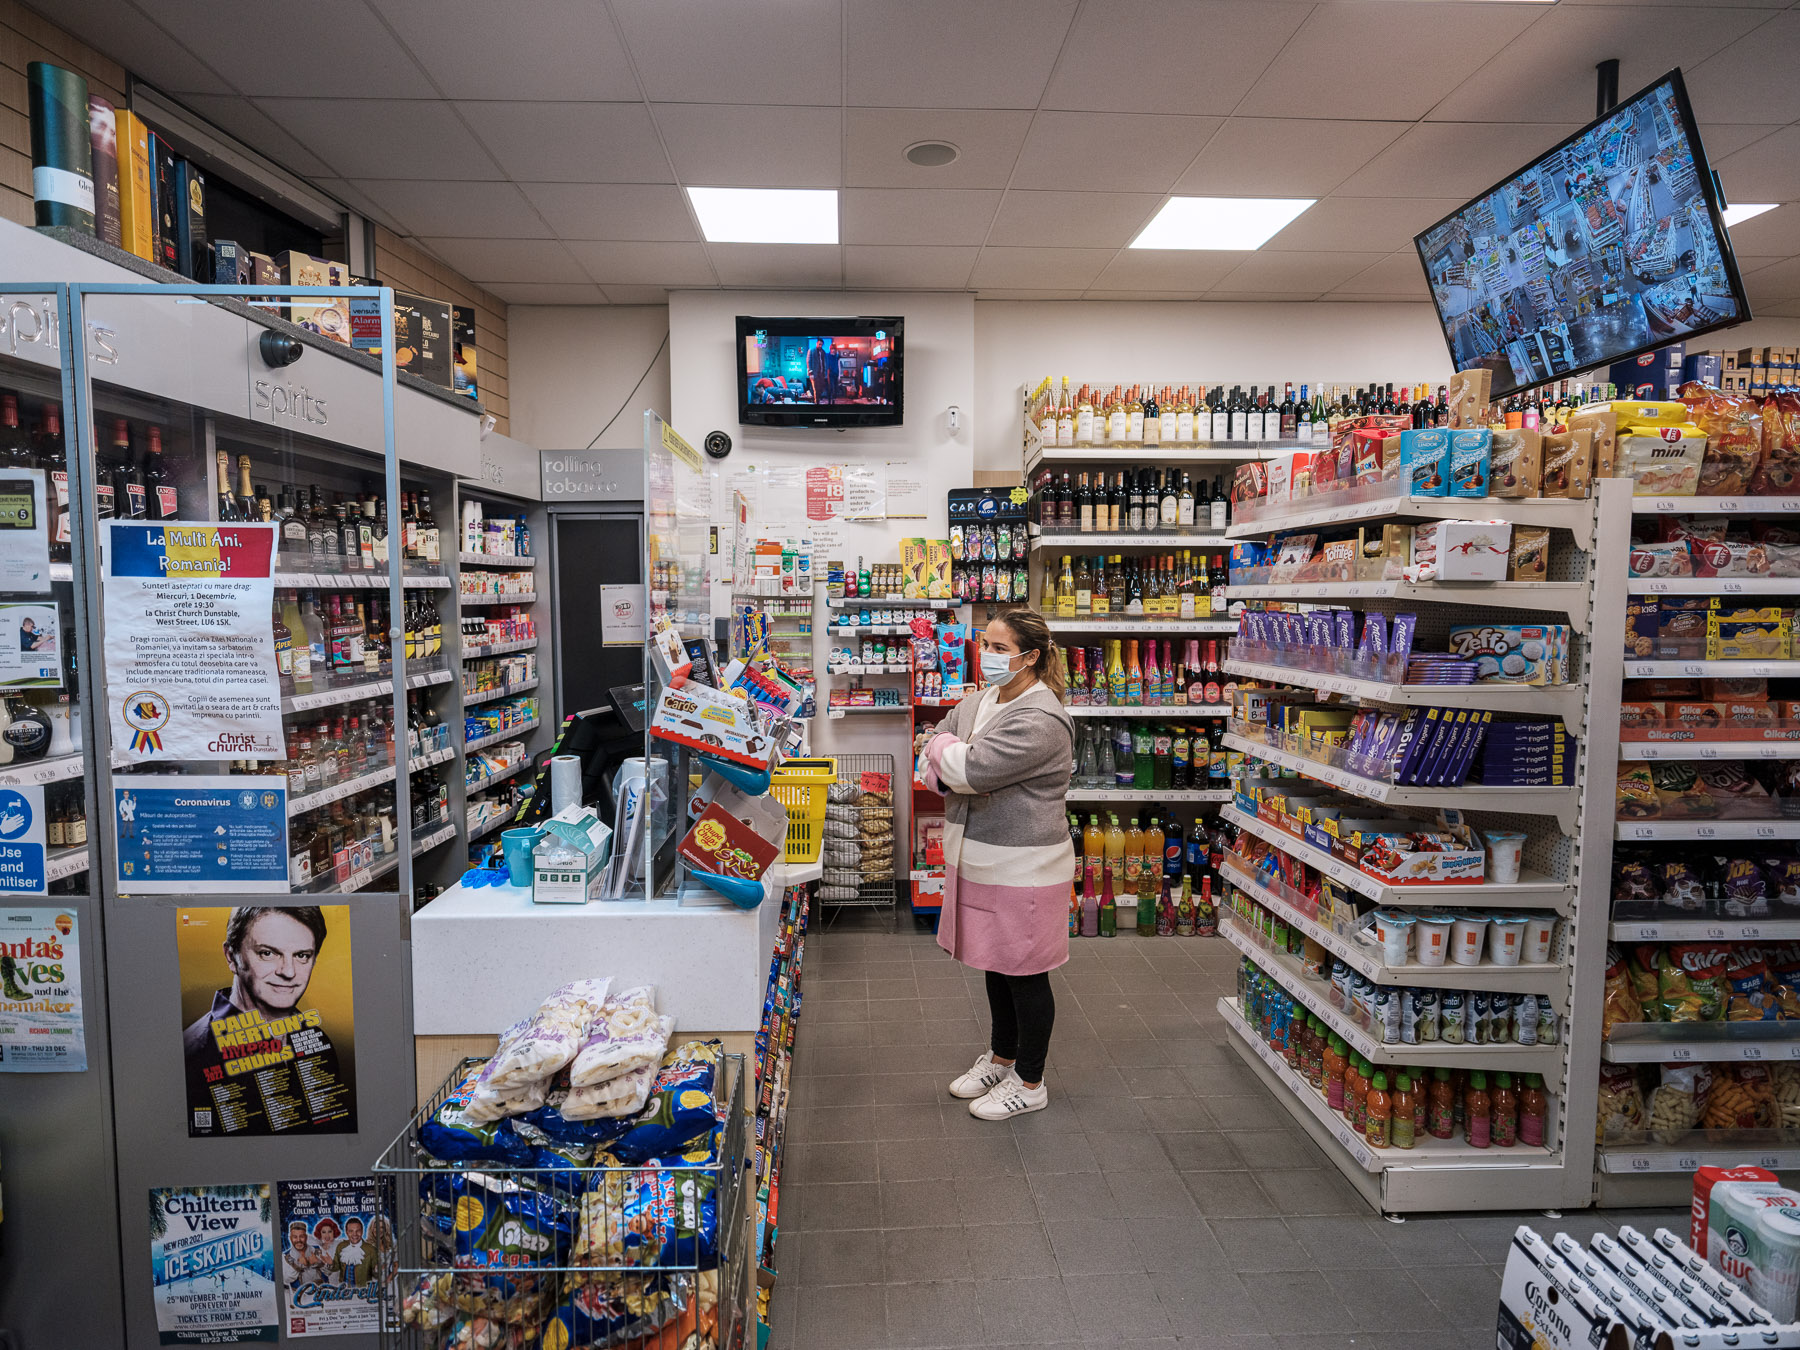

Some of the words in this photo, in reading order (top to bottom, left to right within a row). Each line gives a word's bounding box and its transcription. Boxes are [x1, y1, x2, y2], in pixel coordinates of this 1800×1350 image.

[353, 316, 380, 324] Alarm
[254, 378, 328, 426] spirits
[1650, 444, 1687, 459] mini
[545, 455, 603, 477] rolling
[545, 478, 617, 494] tobacco
[826, 484, 844, 497] 18
[949, 502, 974, 512] CAR
[20, 510, 26, 520] 5
[146, 530, 166, 546] La
[169, 531, 207, 547] Multi
[211, 531, 242, 548] Ani,
[1324, 547, 1353, 562] Toffifee
[158, 555, 231, 571] Romania!
[142, 582, 170, 590] Sunteti
[171, 583, 202, 591] asteptati
[233, 582, 251, 591] drag:
[156, 593, 189, 601] Miercuri,
[196, 593, 237, 601] Decembrie,
[194, 601, 214, 609] 19:30
[145, 609, 153, 617] la
[204, 610, 240, 618] Dunstable,
[156, 618, 174, 626] West
[175, 618, 200, 626] Street,
[201, 618, 215, 626] LU6
[130, 635, 150, 644] Dragi
[1395, 621, 1407, 651] Milka
[1454, 627, 1508, 659] Zeffo
[184, 668, 225, 676] traditionala
[226, 669, 268, 677] romaneasca,
[208, 695, 217, 703] de
[664, 697, 698, 713] Cards
[172, 703, 197, 711] invitati
[232, 703, 240, 711] de
[1527, 723, 1549, 732] fingers
[218, 732, 256, 744] Christ
[1527, 734, 1549, 742] fingers
[207, 741, 253, 752] Church
[1527, 744, 1549, 753] fingers
[40, 770, 56, 779] 19.99
[1653, 762, 1697, 787] Rolls
[174, 798, 231, 807] Coronavirus
[697, 828, 718, 846] Chups
[702, 823, 724, 842] Chupa
[734, 848, 753, 863] Cola
[0, 861, 24, 872] and
[1726, 859, 1754, 882] JOE
[0, 875, 38, 888] nitiser
[0, 935, 64, 960] anta's
[1741, 978, 1761, 989] SARE
[34, 987, 51, 996] and
[54, 987, 69, 996] the
[210, 1009, 266, 1036] PAUL
[216, 1010, 321, 1053] MERTON'S
[221, 1038, 283, 1060] IMPRO
[224, 1045, 295, 1076] CHUMS
[206, 1071, 224, 1083] 2022
[164, 1196, 257, 1215] Chiltern
[296, 1199, 312, 1207] ANDY
[335, 1196, 356, 1205] MARK
[293, 1207, 315, 1215] COLLINS
[333, 1205, 359, 1214] RHODES
[183, 1215, 240, 1232] View
[163, 1239, 178, 1251] NEW
[178, 1236, 189, 1249] FOR
[189, 1233, 204, 1245] 2021
[164, 1251, 190, 1280] ICE
[192, 1231, 262, 1274] SKATING
[487, 1249, 530, 1266] Mega
[180, 1293, 216, 1303] NOVEMBER
[233, 1290, 263, 1299] JANUARY
[190, 1302, 206, 1310] OPEN
[207, 1301, 228, 1309] EVERY
[1524, 1281, 1571, 1342] Corona
[177, 1314, 208, 1323] TICKETS
[210, 1312, 232, 1321] FROM
[235, 1310, 257, 1320] £7.50
[176, 1330, 208, 1338] Chiltern
[210, 1329, 229, 1337] View
[231, 1328, 262, 1336] Nursery
[1532, 1309, 1559, 1347] Extra
